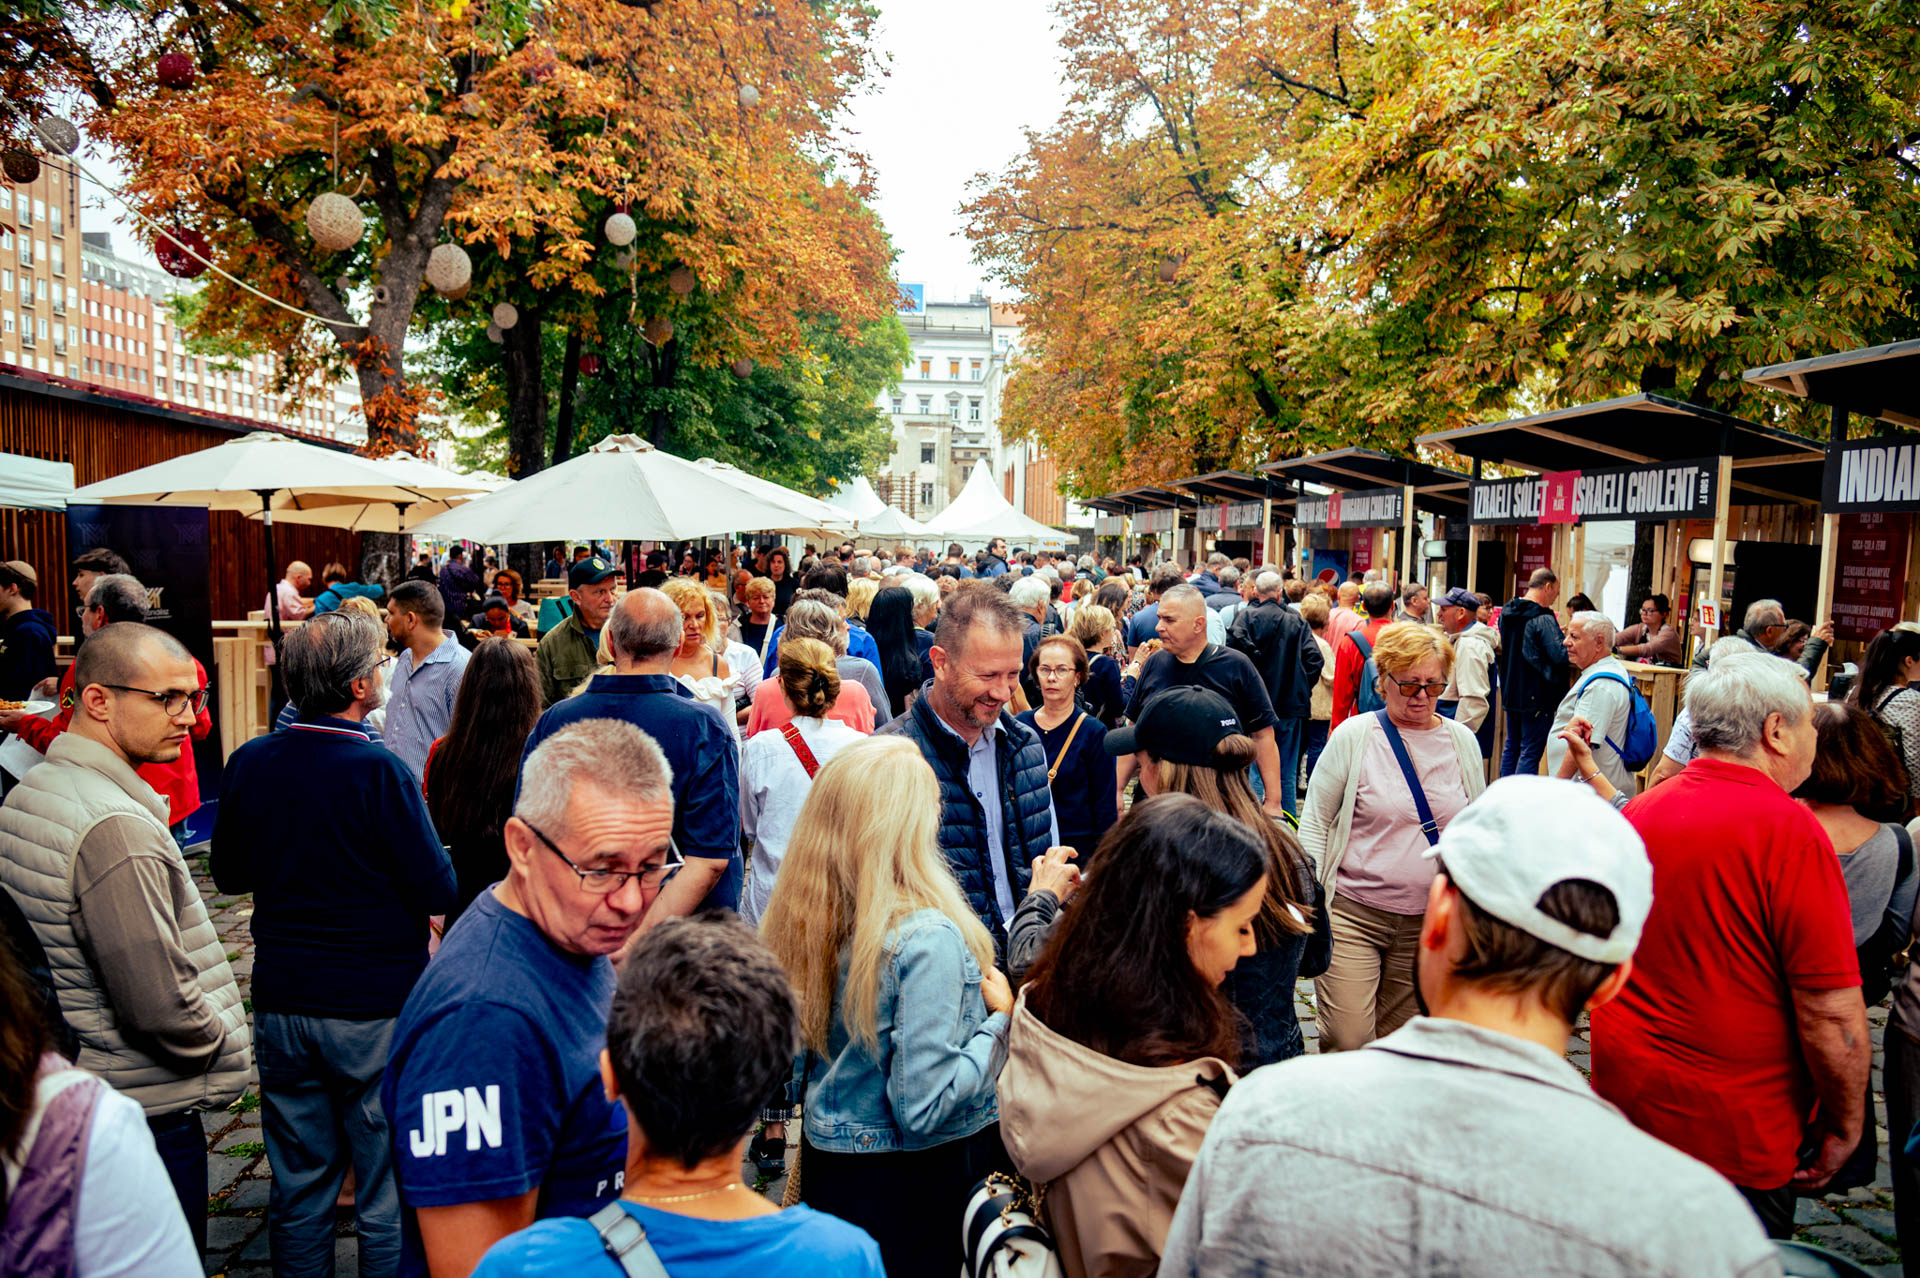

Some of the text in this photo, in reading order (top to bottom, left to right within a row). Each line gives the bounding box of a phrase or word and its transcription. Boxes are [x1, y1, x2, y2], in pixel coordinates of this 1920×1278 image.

[1473, 477, 1549, 520] IZRAELI SÓLET
[1571, 466, 1699, 516] ISRAELI CHOLENT
[1698, 494, 1708, 504] FT
[409, 1084, 502, 1158] JPN
